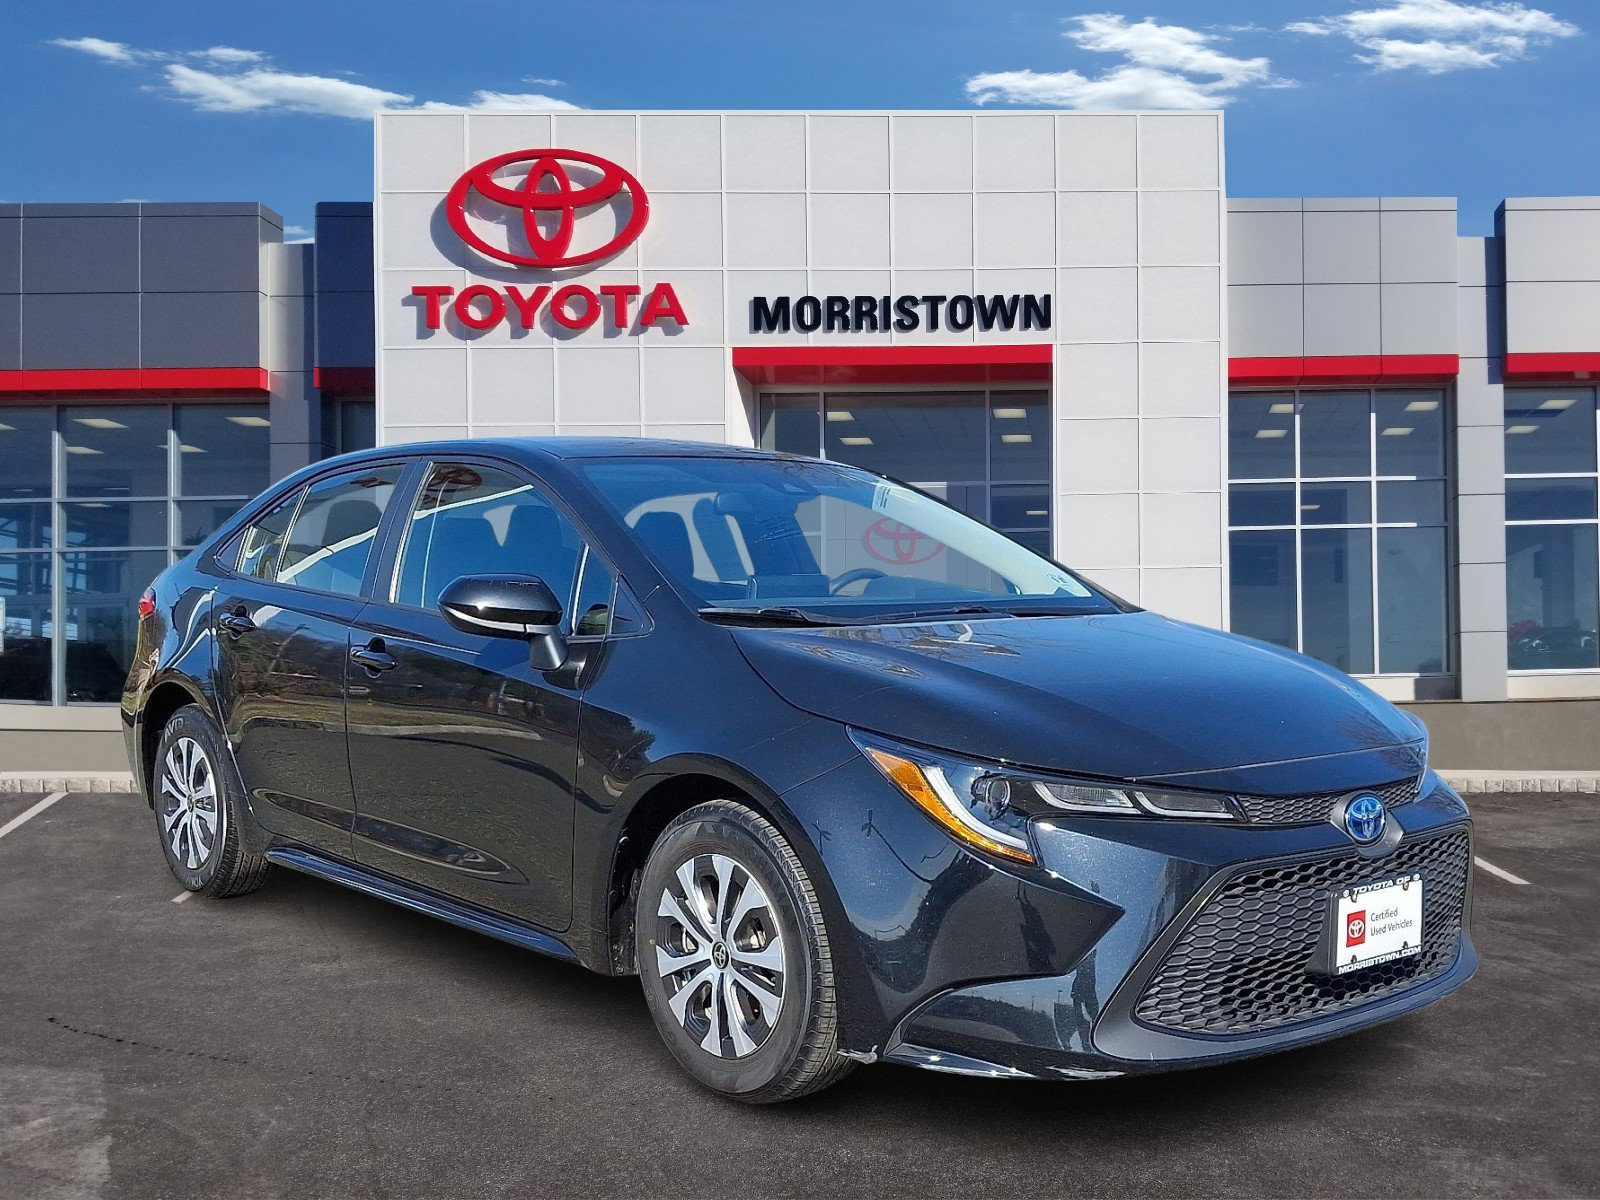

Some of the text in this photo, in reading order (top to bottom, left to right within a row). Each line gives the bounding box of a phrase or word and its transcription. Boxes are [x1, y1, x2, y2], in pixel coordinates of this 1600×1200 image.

[411, 283, 690, 329] TOYOTA
[753, 293, 1052, 331] MORRISTOWN
[1353, 876, 1411, 896] TOYOTA OF
[1371, 907, 1399, 922] Certified
[1371, 918, 1413, 937] Used Vehicles
[1339, 945, 1422, 975] MORRISTOWN.COM
